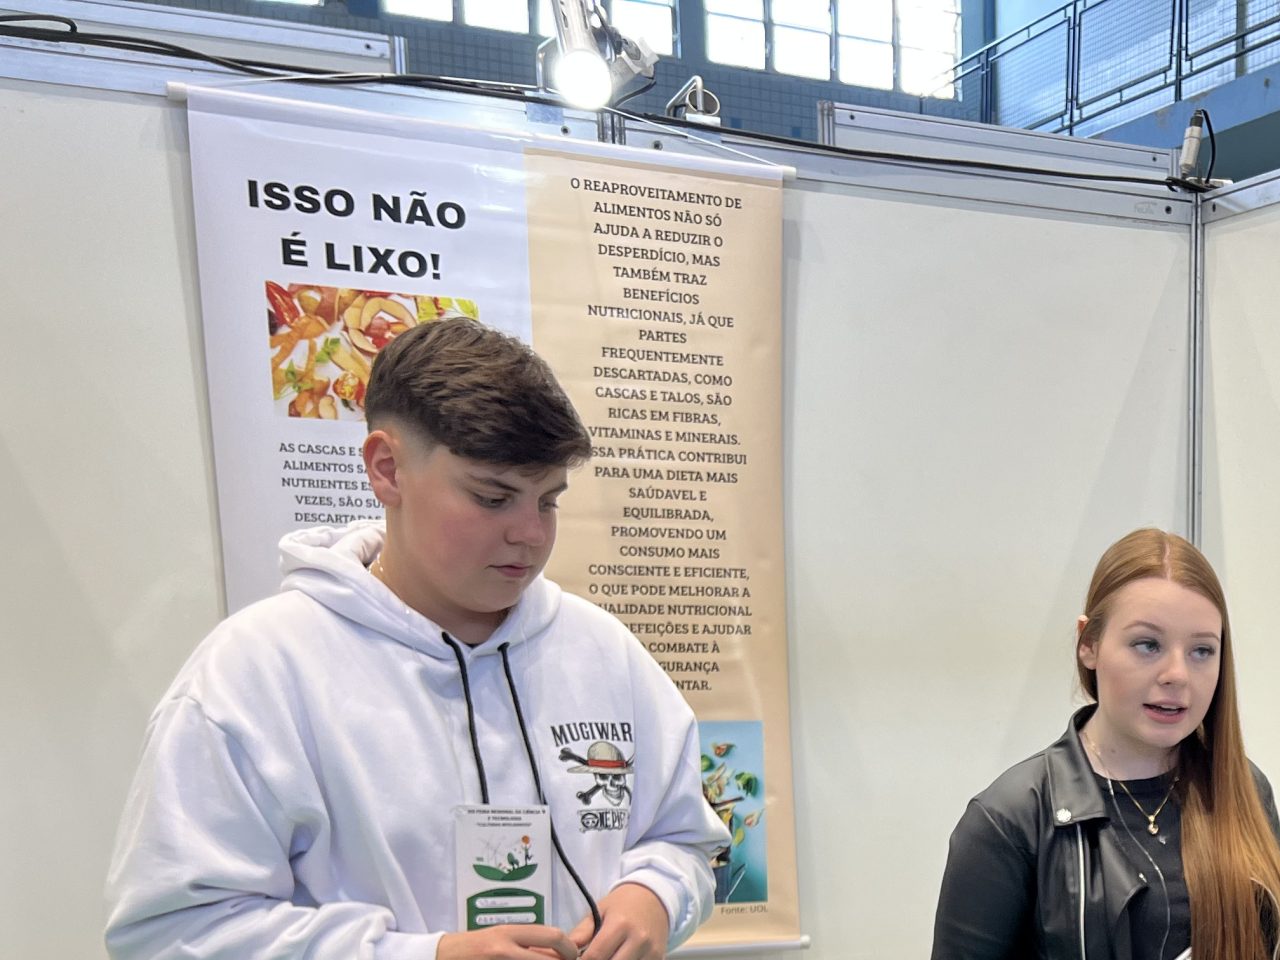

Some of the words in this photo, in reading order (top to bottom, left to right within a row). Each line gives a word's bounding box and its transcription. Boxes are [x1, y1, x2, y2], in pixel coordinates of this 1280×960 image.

[570, 178, 580, 189] O
[584, 179, 722, 207] REAPROVEITAMENTO
[724, 197, 742, 209] DE
[248, 179, 355, 217] ISSO
[372, 191, 466, 230] NÃO
[593, 202, 671, 221] ALIMENTOS
[674, 210, 703, 225] NÃO
[705, 214, 722, 227] SÓ
[593, 222, 640, 239] AJUDA
[643, 229, 651, 239] A
[655, 230, 712, 246] REDUZIR
[714, 236, 723, 247] O
[281, 231, 308, 267] É
[325, 242, 441, 280] LIXO!
[598, 244, 689, 266] DESPERDÍCIO,
[692, 254, 720, 267] MAS
[613, 266, 671, 282] TAMBÉM
[673, 272, 708, 286] TRAZ
[623, 288, 700, 304] BENEFÍCIOS
[588, 304, 687, 326] NUTRICIONAIS,
[689, 312, 705, 326] JÁ
[708, 316, 734, 328] QUE
[638, 330, 687, 344] PARTES
[602, 347, 724, 366] FREQUENTEMENTE
[593, 366, 692, 385] DESCARTADAS,
[694, 374, 732, 386] COMO
[595, 386, 647, 400] CASCAS
[650, 390, 658, 401] E
[660, 391, 704, 406] TALOS,
[706, 392, 732, 406] SÃO
[608, 408, 647, 420] RICAS
[650, 411, 670, 422] EM
[672, 412, 722, 426] FIBRAS,
[588, 426, 662, 441] VITAMINAS
[665, 430, 672, 441] E
[676, 432, 741, 446] MINERAIS.
[280, 443, 295, 452] AS
[298, 444, 346, 456] CASCAS
[349, 448, 356, 456] E
[591, 446, 615, 458] SSA
[618, 446, 675, 462] PRÁTICA
[678, 451, 747, 465] CONTRIBUI
[283, 460, 354, 473] ALIMENTOS
[594, 466, 630, 478] PARA
[632, 468, 663, 480] UMA
[666, 472, 704, 482] DIETA
[706, 472, 738, 484] MAIS
[282, 478, 358, 490] NUTRIENTES
[296, 495, 336, 508] VEZES,
[339, 496, 362, 508] SÃO
[628, 486, 696, 501] SAÚDAVEL
[700, 490, 707, 501] E
[623, 506, 714, 522] EQUILIBRADA,
[611, 526, 704, 540] PROMOVENDO
[706, 529, 727, 540] UM
[620, 546, 685, 558] CONSUMO
[688, 548, 720, 559] MAIS
[588, 564, 670, 577] CONSCIENTE
[674, 566, 681, 577] E
[684, 567, 750, 580] EFICIENTE,
[589, 584, 598, 594] O
[601, 584, 628, 597] QUE
[631, 584, 666, 596] PODE
[668, 586, 740, 598] MELHORAR
[742, 587, 751, 598] A
[597, 604, 664, 616] UALIDADE
[668, 604, 752, 617] NUTRICIONAL
[692, 624, 699, 634] E
[702, 624, 752, 634] AJUDAR
[648, 642, 708, 654] COMBATE
[712, 640, 720, 654] À
[660, 662, 720, 674] GURANÇA
[550, 722, 633, 747] MUGIWAR
[720, 906, 747, 915] Fonte:
[750, 904, 768, 913] UOL
